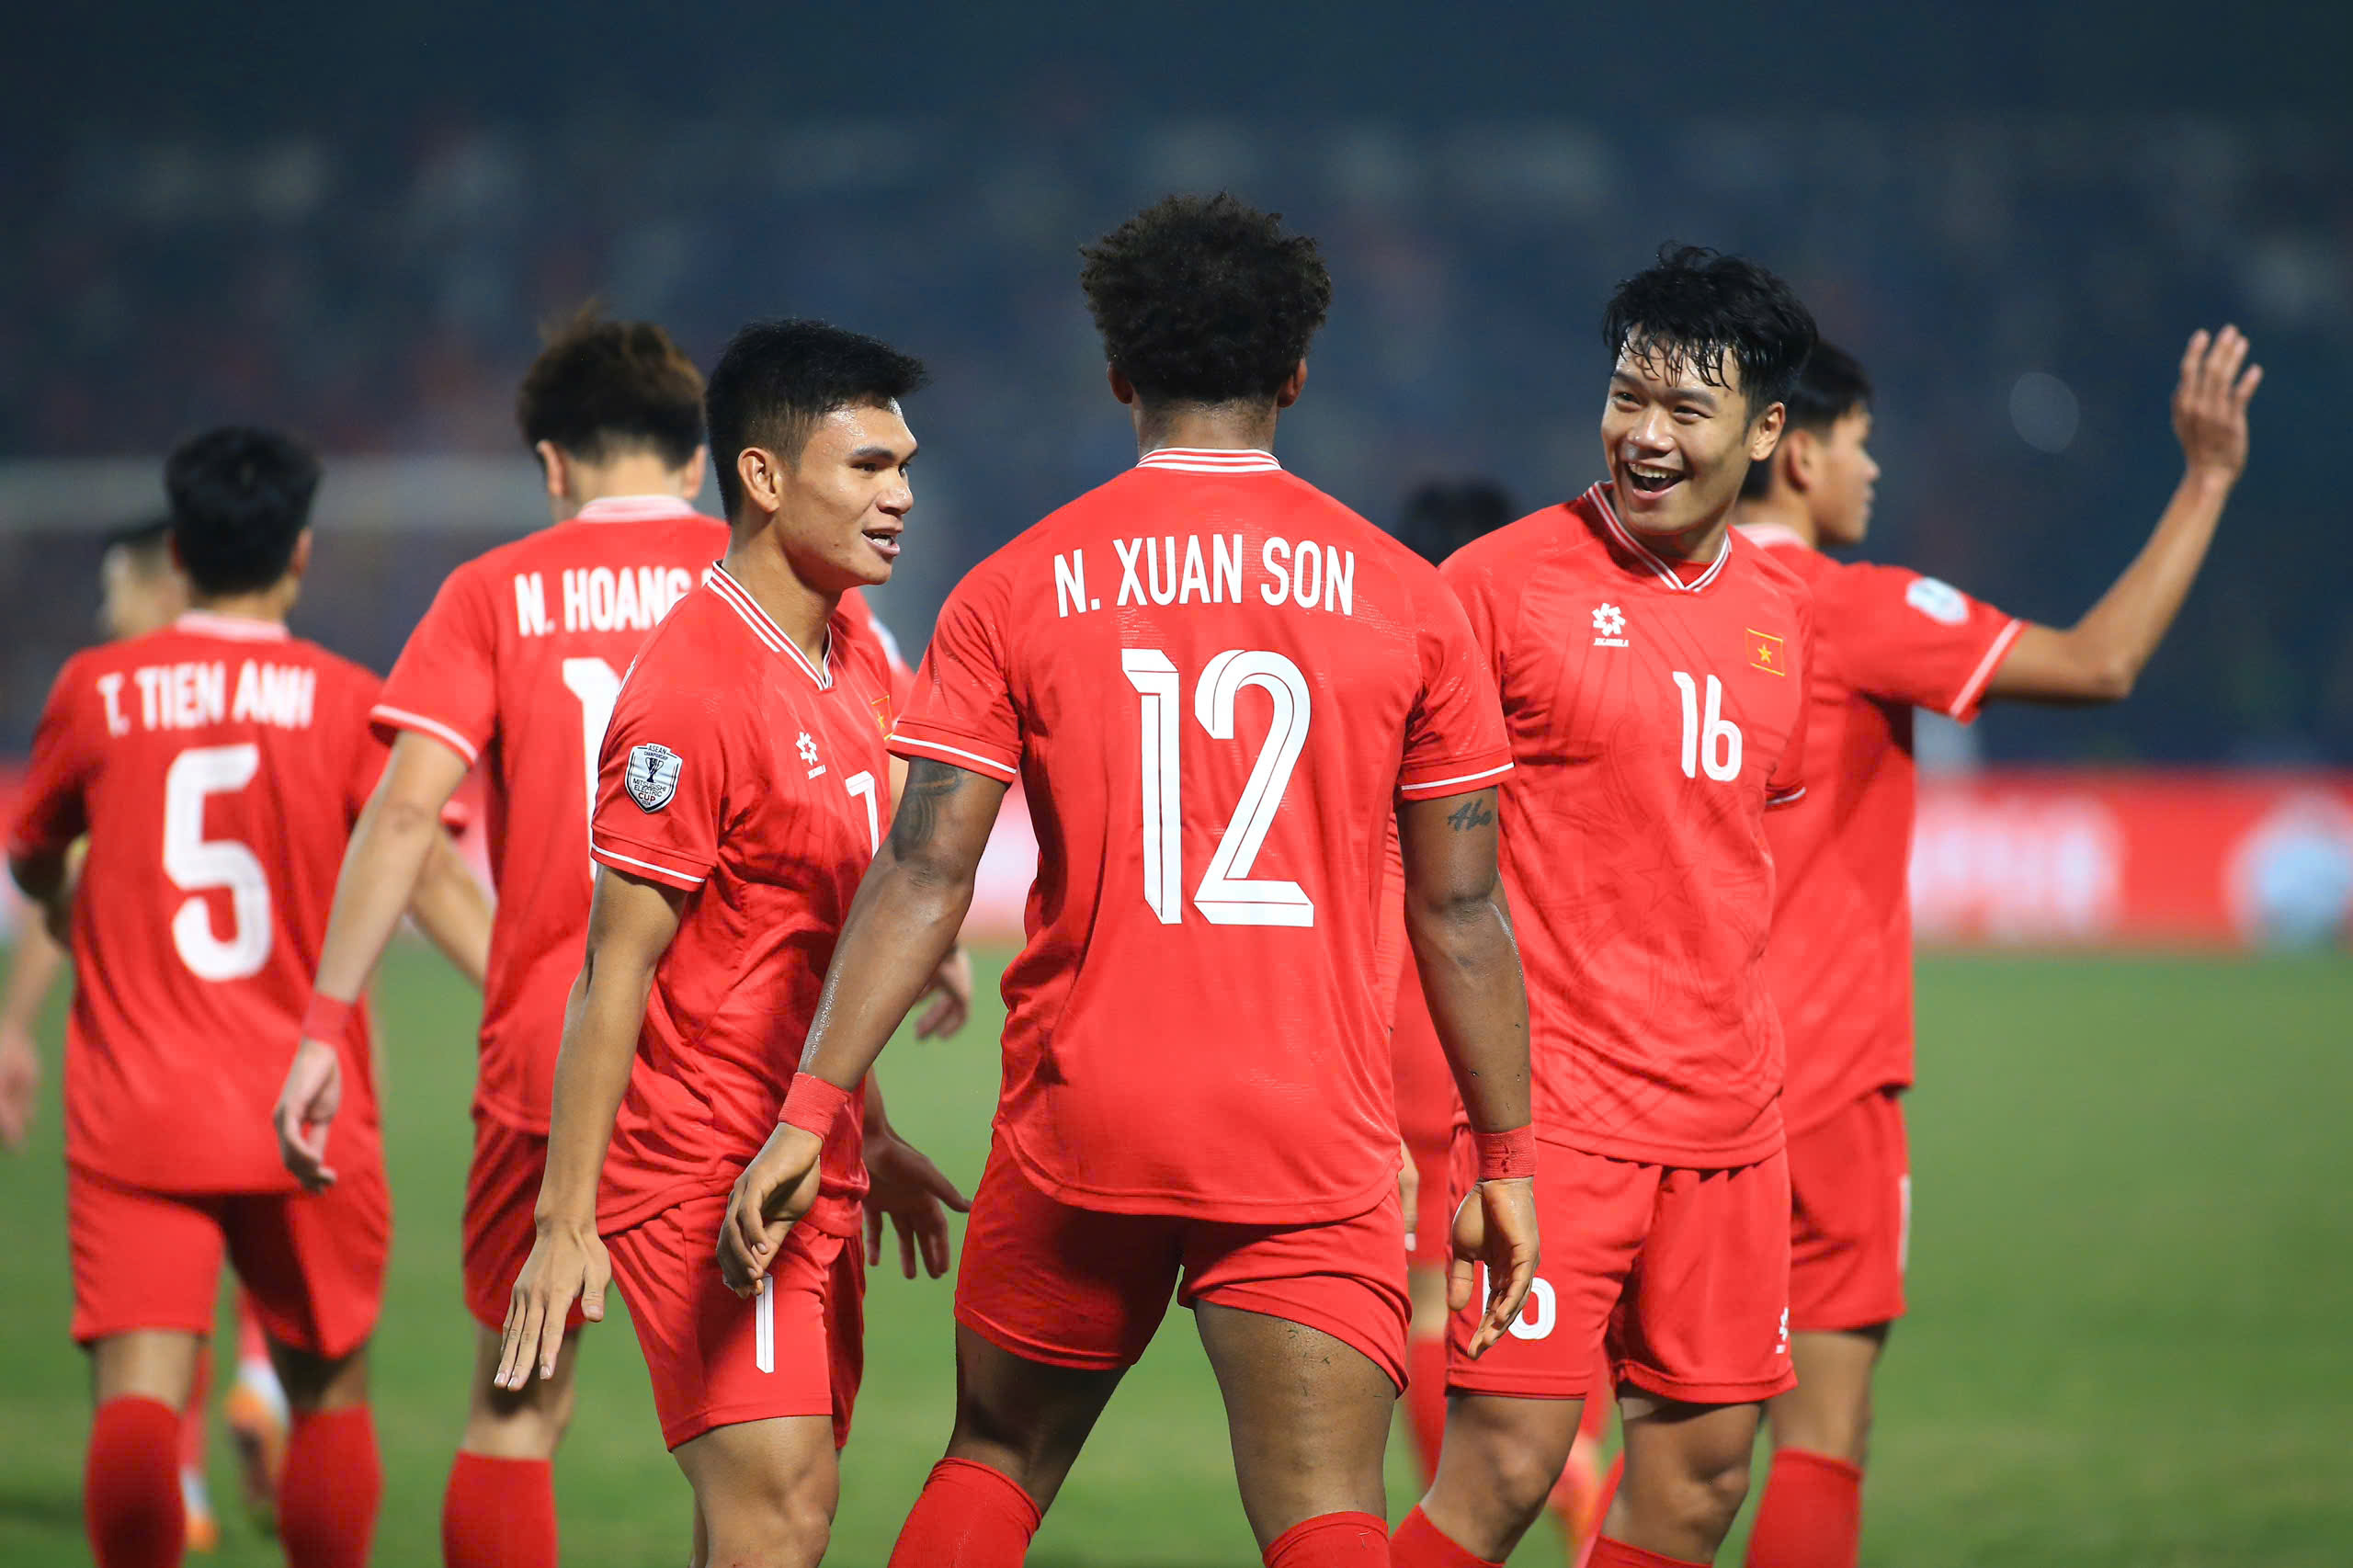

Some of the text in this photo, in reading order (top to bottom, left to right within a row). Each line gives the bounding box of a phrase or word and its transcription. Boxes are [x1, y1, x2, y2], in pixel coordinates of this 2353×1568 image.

[514, 572, 556, 637] N.
[1053, 533, 1356, 619] N. XUAN SON
[97, 659, 316, 737] T. TIEN ANH
[1672, 671, 1743, 781] 16
[648, 744, 667, 755] ASEAN
[1121, 648, 1314, 927] 12
[639, 792, 655, 802] CUP
[845, 770, 880, 858] 7
[164, 744, 273, 982] 5
